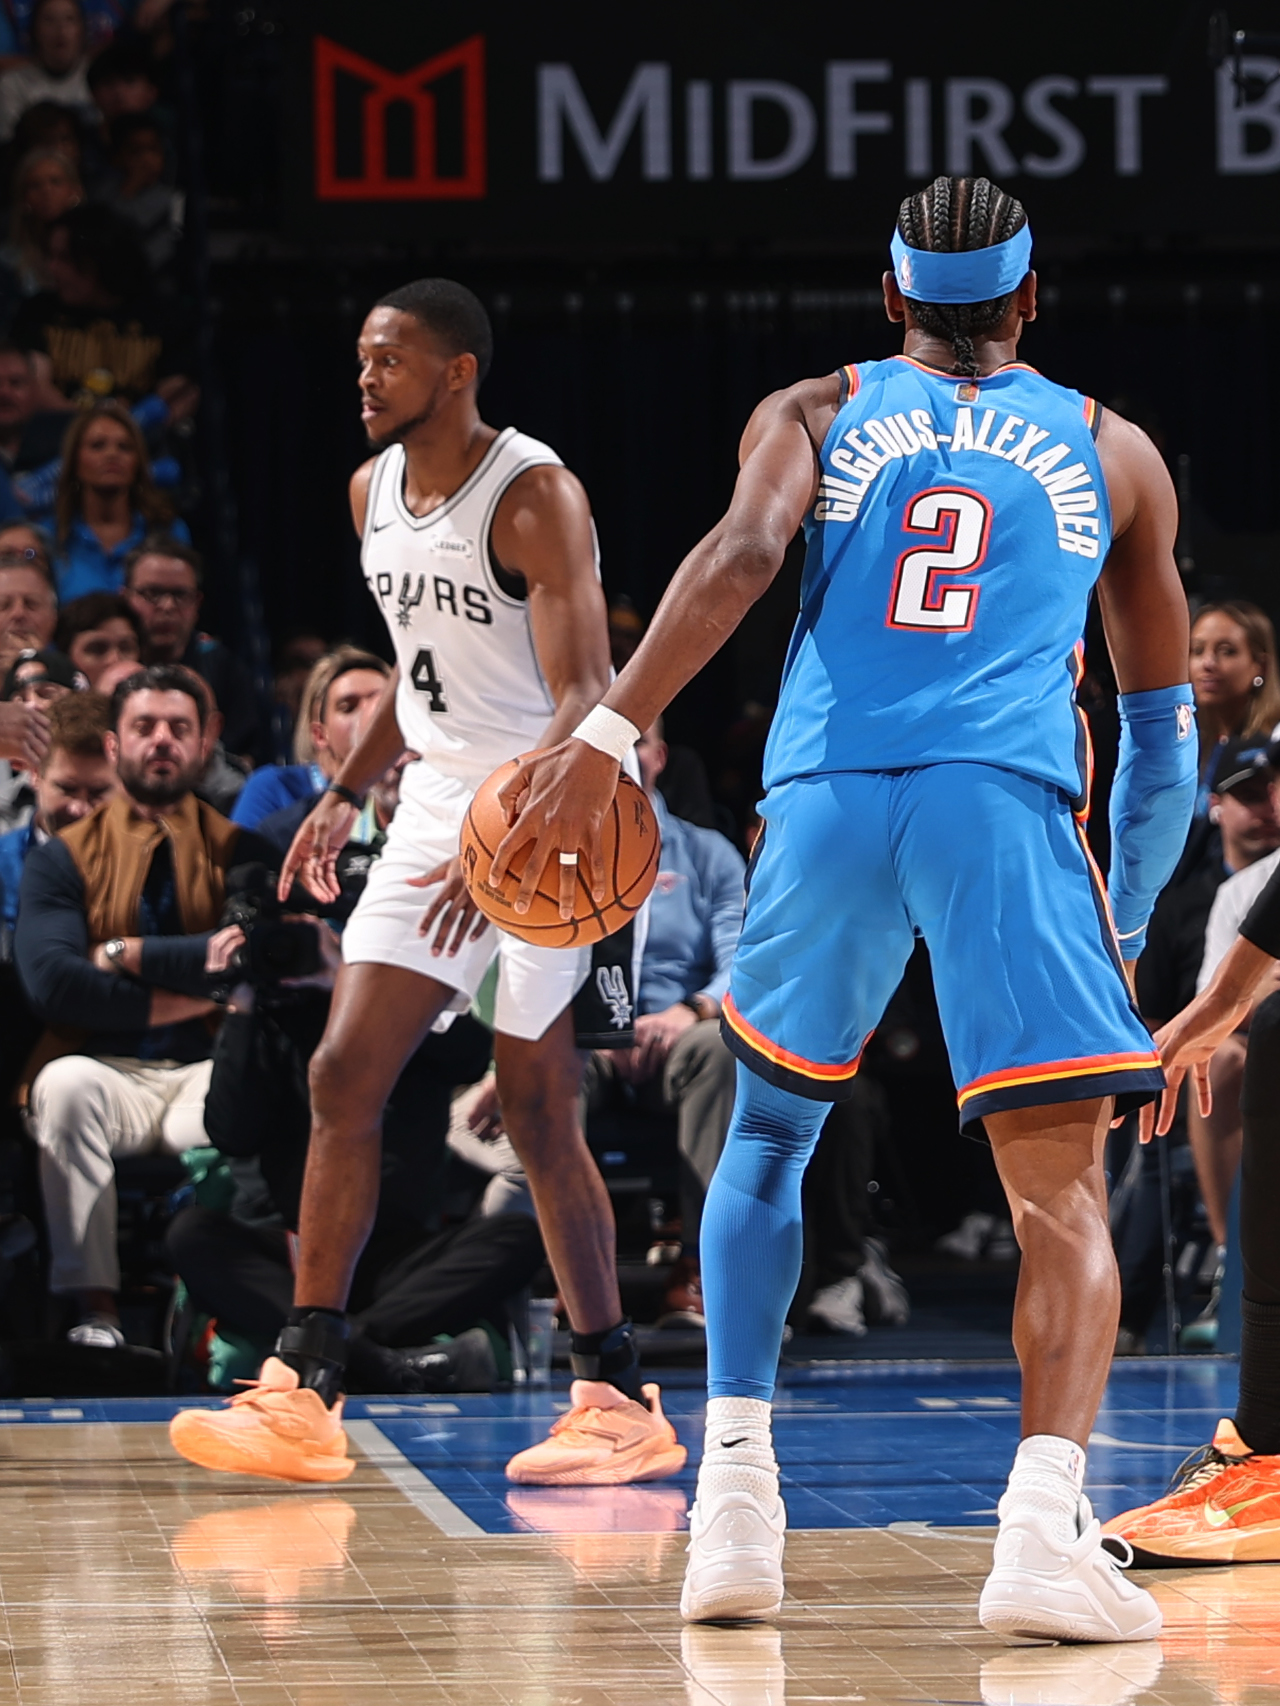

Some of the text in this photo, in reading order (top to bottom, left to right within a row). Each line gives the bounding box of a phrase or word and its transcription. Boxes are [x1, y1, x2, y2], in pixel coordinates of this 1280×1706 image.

[813, 406, 1101, 560] GILGEOUS-ALEXANDER
[366, 571, 493, 628] PURS
[885, 485, 993, 634] 2
[410, 645, 450, 714] 4
